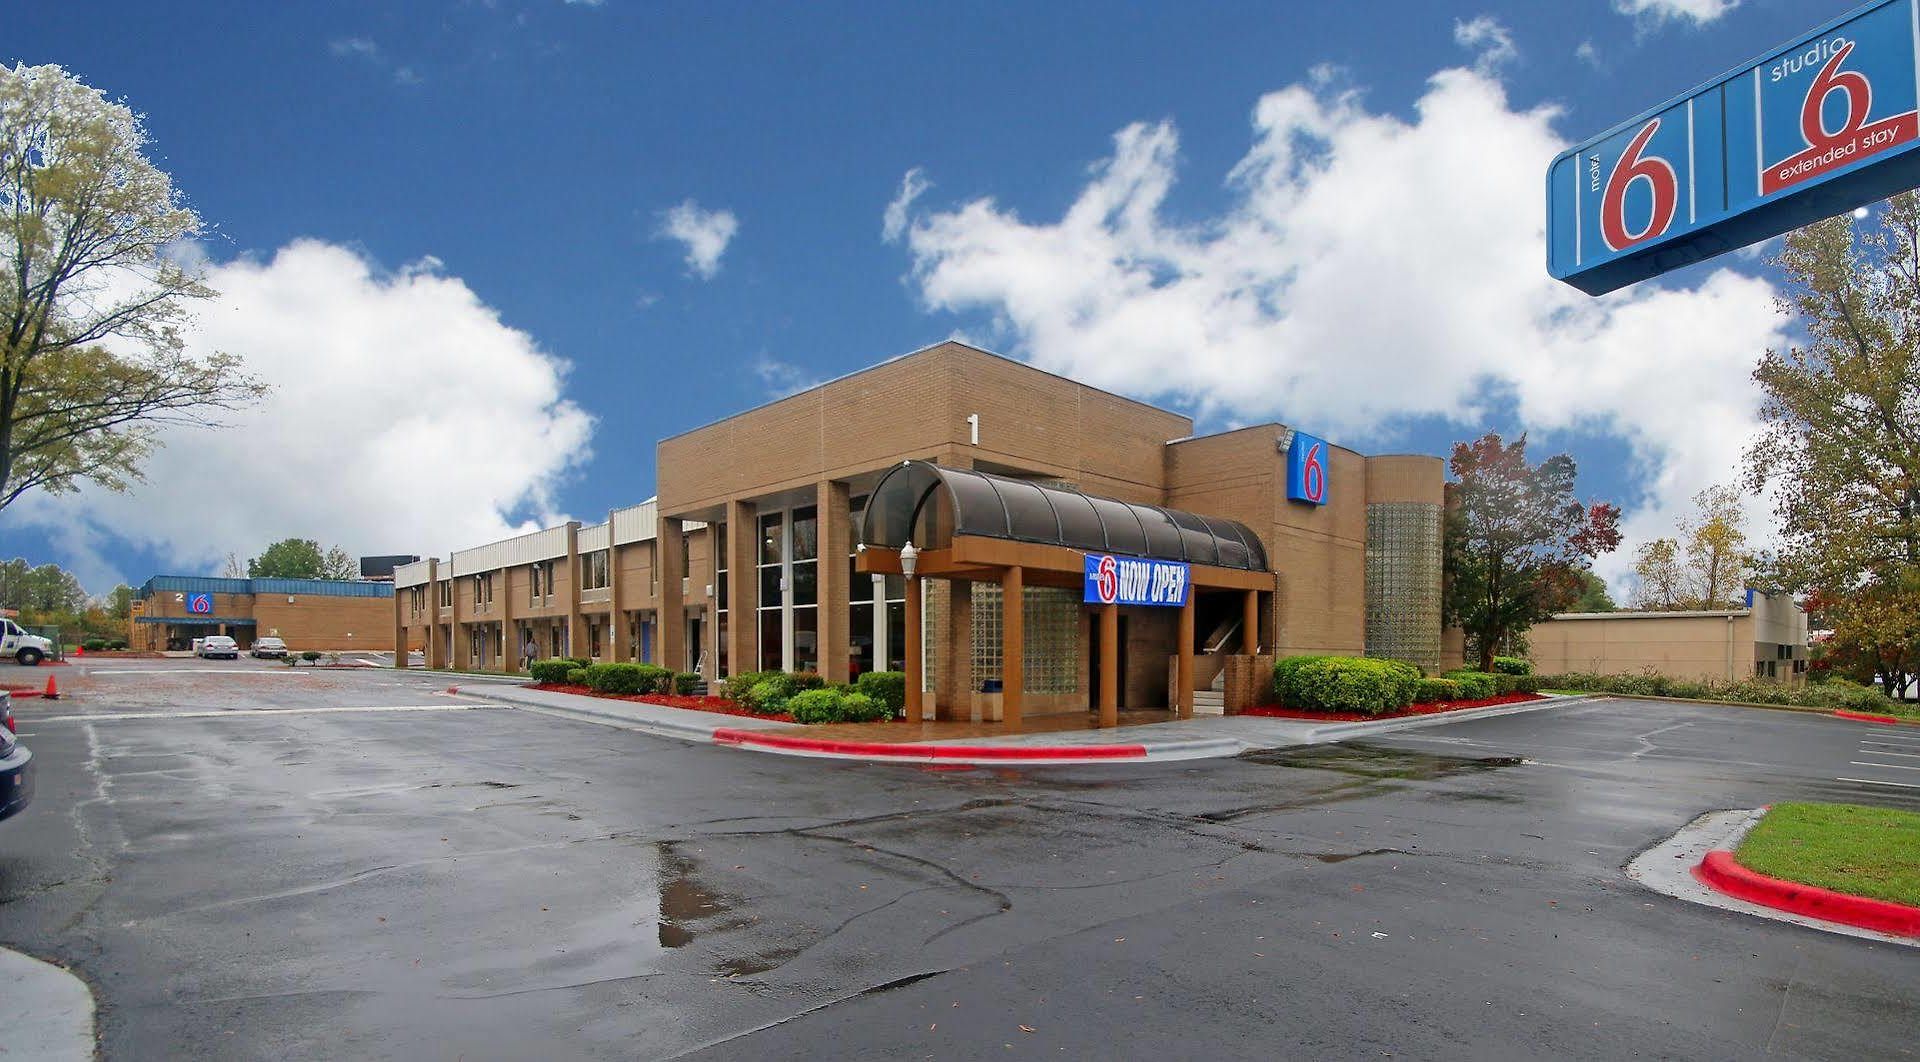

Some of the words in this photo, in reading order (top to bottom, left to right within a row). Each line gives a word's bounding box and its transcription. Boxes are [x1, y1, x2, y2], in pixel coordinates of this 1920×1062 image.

[1771, 37, 1846, 82] studio
[1800, 40, 1873, 149] 6
[1779, 138, 1857, 180] extended
[1862, 125, 1900, 149] stay
[1590, 153, 1600, 192] motel
[1600, 118, 1678, 252] 6
[967, 413, 979, 445] 1
[1303, 442, 1324, 503] 6
[175, 593, 184, 602] 2
[193, 594, 209, 613] 6
[1098, 555, 1118, 604] 6
[1119, 560, 1150, 602] NOW
[1151, 563, 1185, 603] OPEN
